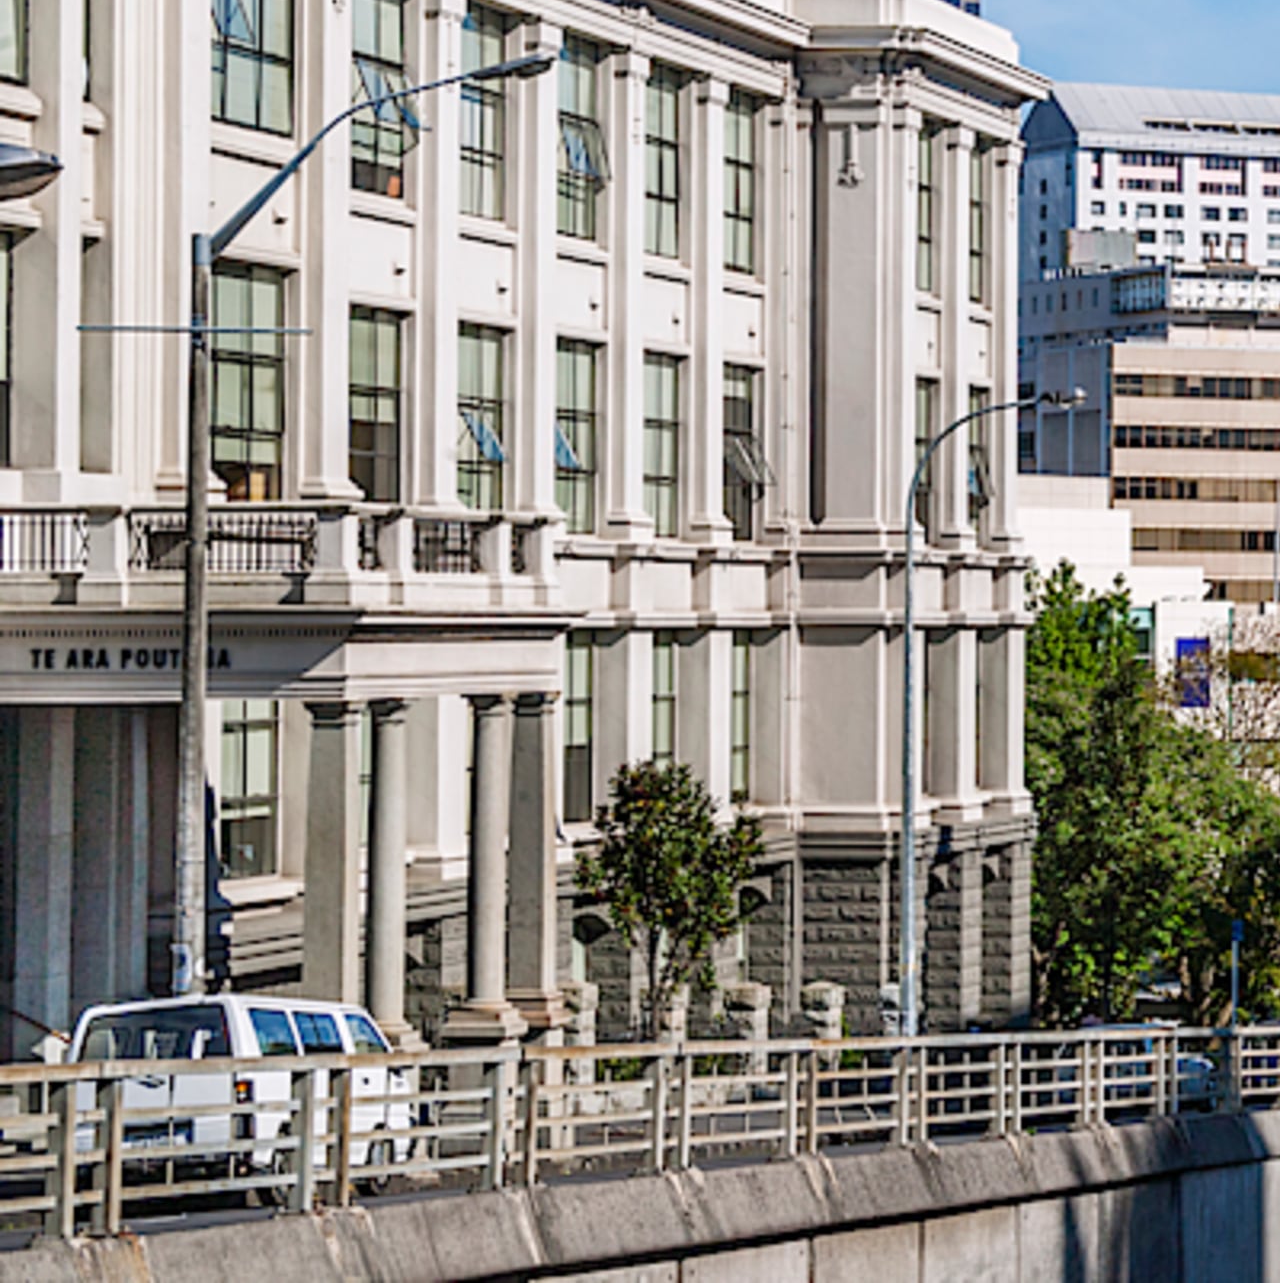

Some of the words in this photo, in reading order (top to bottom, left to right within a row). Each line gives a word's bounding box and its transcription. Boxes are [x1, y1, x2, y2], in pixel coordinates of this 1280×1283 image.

[30, 648, 56, 669] TE
[66, 648, 110, 669] ARA
[120, 648, 231, 669] POUTA
